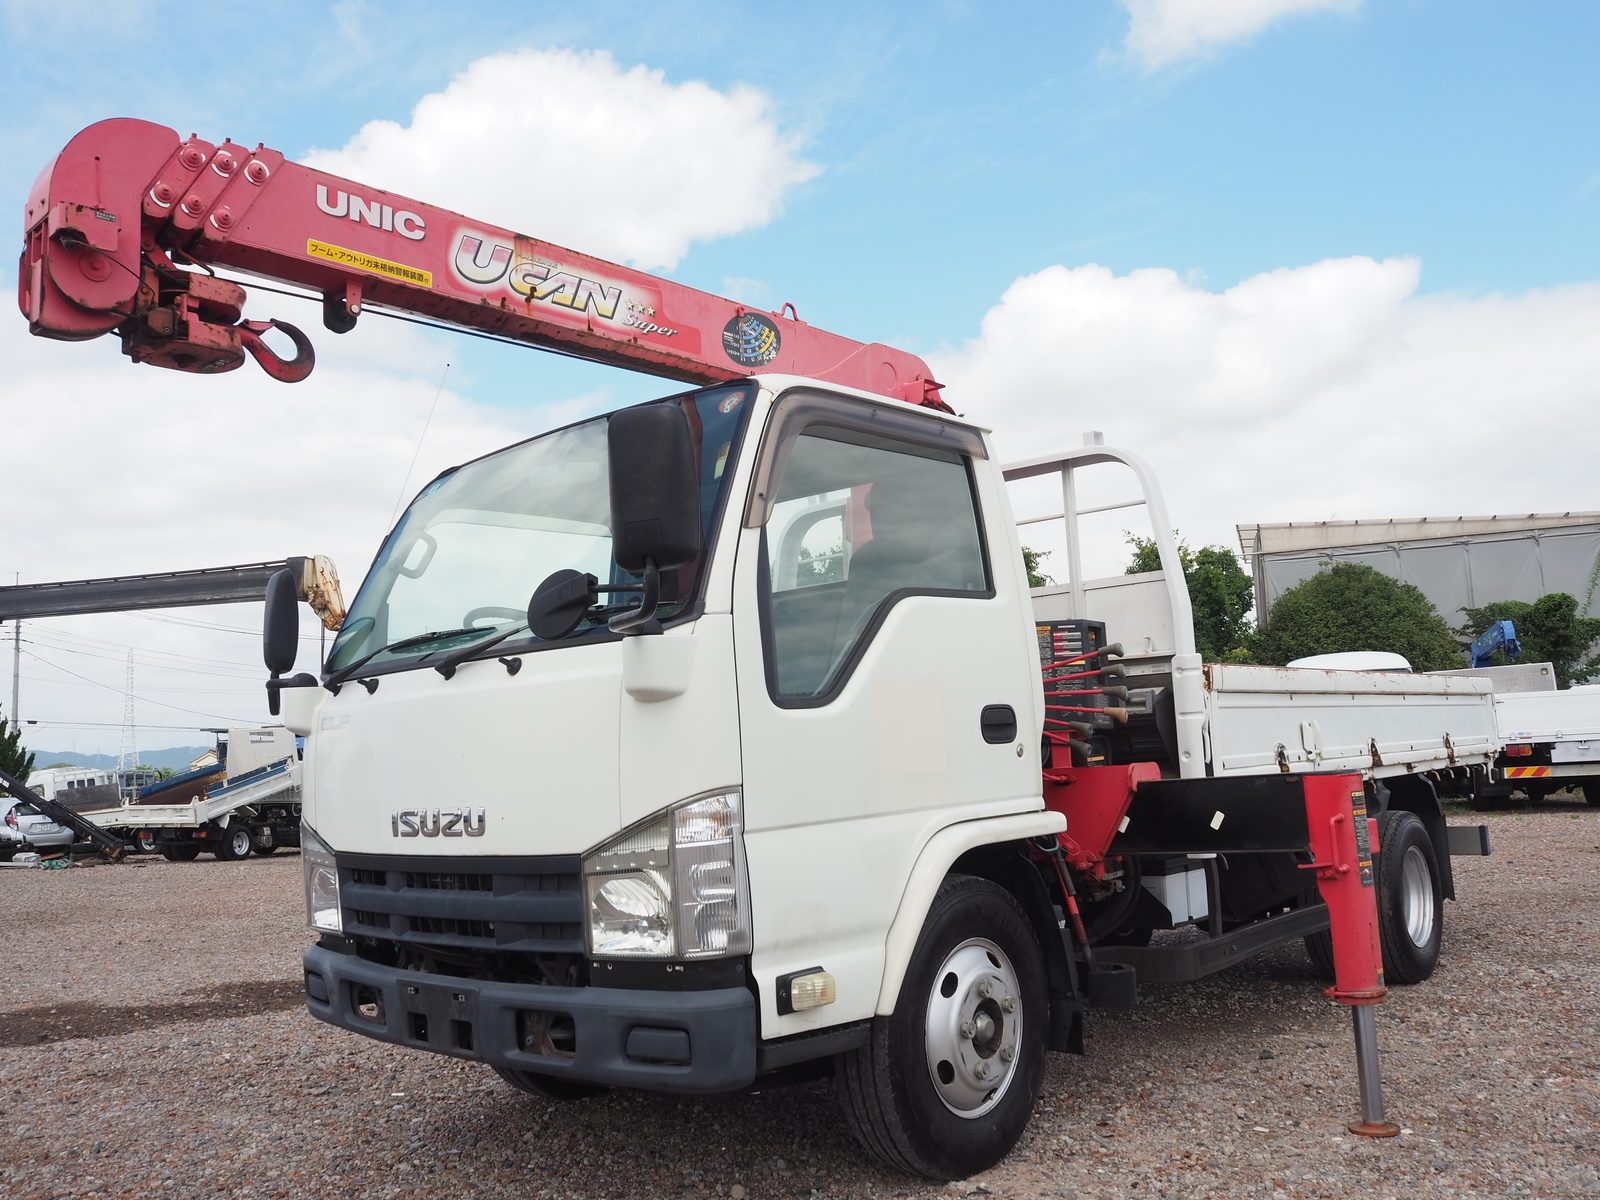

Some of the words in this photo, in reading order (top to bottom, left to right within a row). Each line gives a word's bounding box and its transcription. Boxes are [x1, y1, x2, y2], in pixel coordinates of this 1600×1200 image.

[316, 184, 426, 240] UNIC
[455, 234, 622, 320] UCAN
[623, 312, 679, 337] Super
[391, 806, 486, 837] ISUZU
